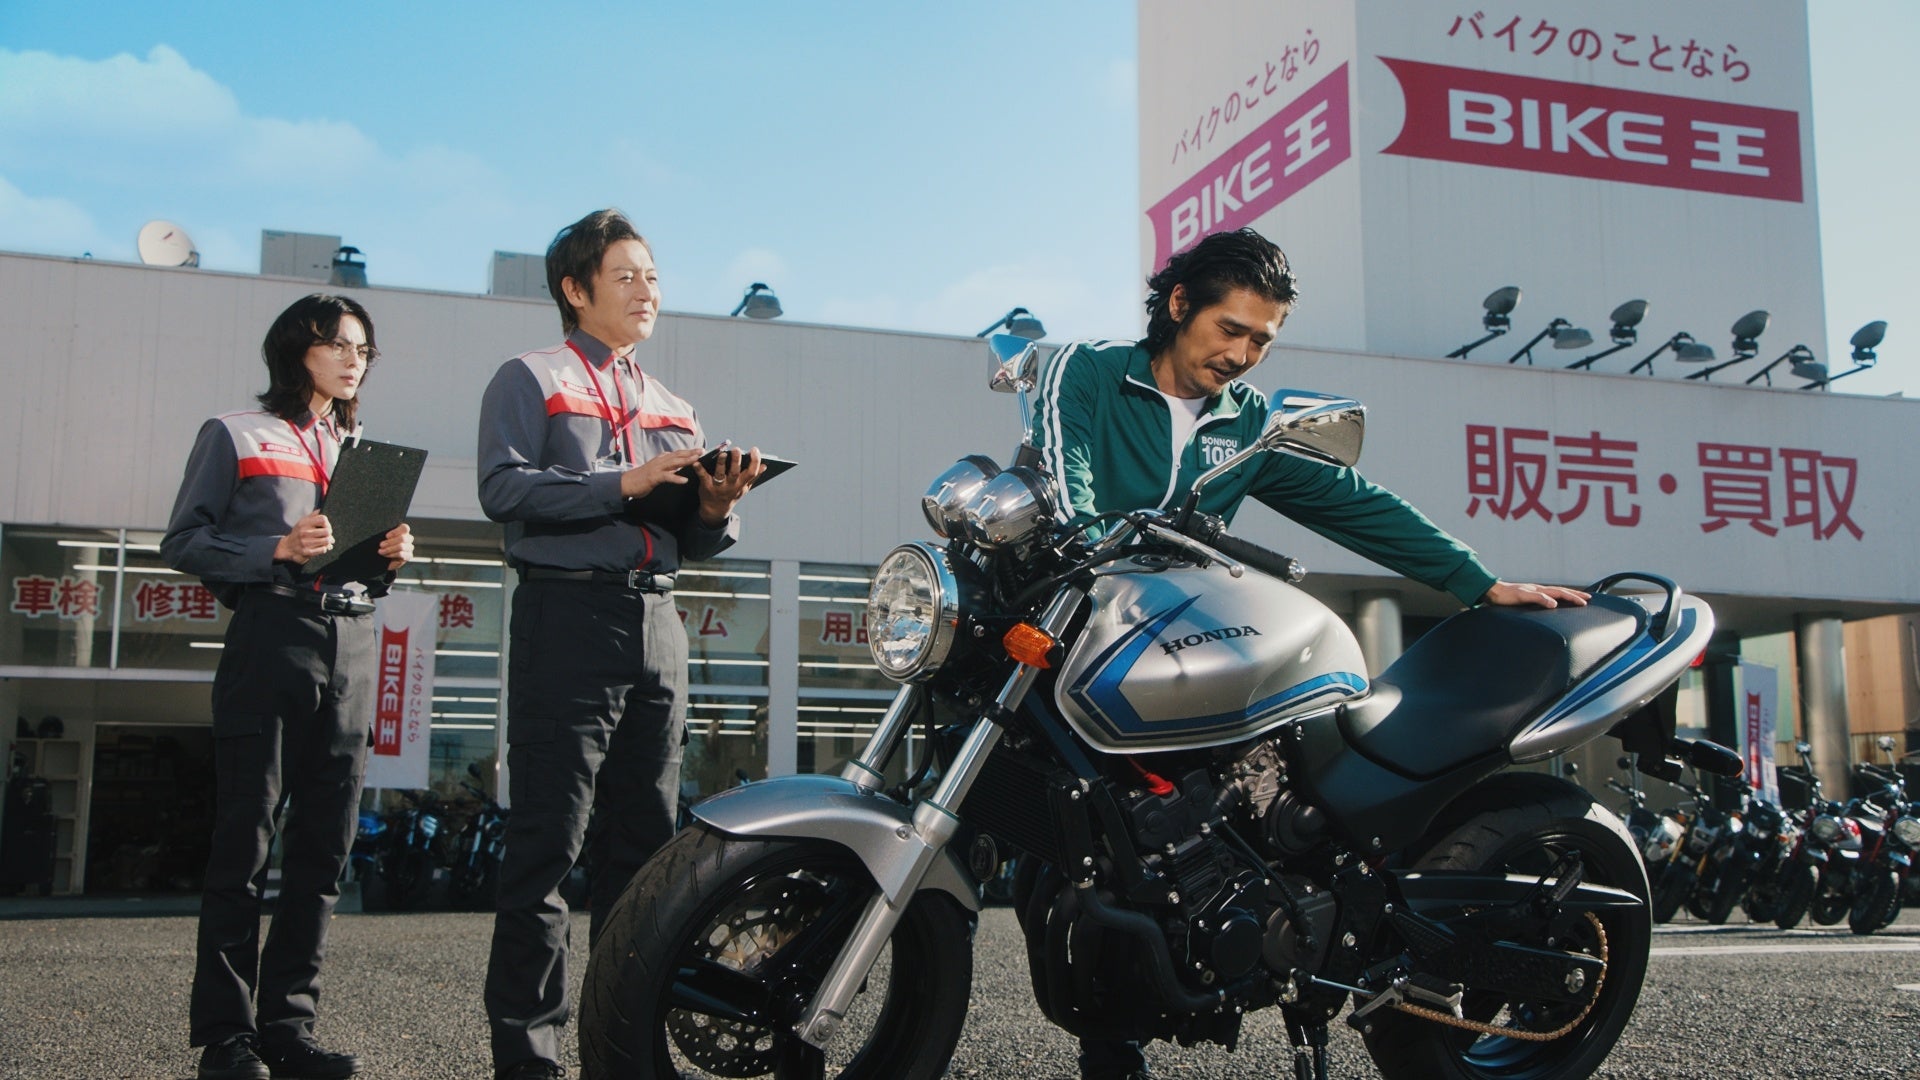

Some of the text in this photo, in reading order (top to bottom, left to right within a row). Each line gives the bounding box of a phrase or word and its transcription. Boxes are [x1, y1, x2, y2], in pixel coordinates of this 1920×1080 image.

[1447, 10, 1751, 83] バイクのことなら
[1171, 28, 1320, 165] バイクのことなら
[1448, 88, 1771, 178] BIKE 王
[1170, 99, 1331, 254] BIKE 王
[1201, 435, 1238, 449] BONNOU
[1465, 423, 1865, 542] 販売・買取
[12, 576, 101, 618] 車検
[134, 581, 217, 619] 修理
[1159, 625, 1263, 656] HONDA
[381, 643, 402, 713] BIKE
